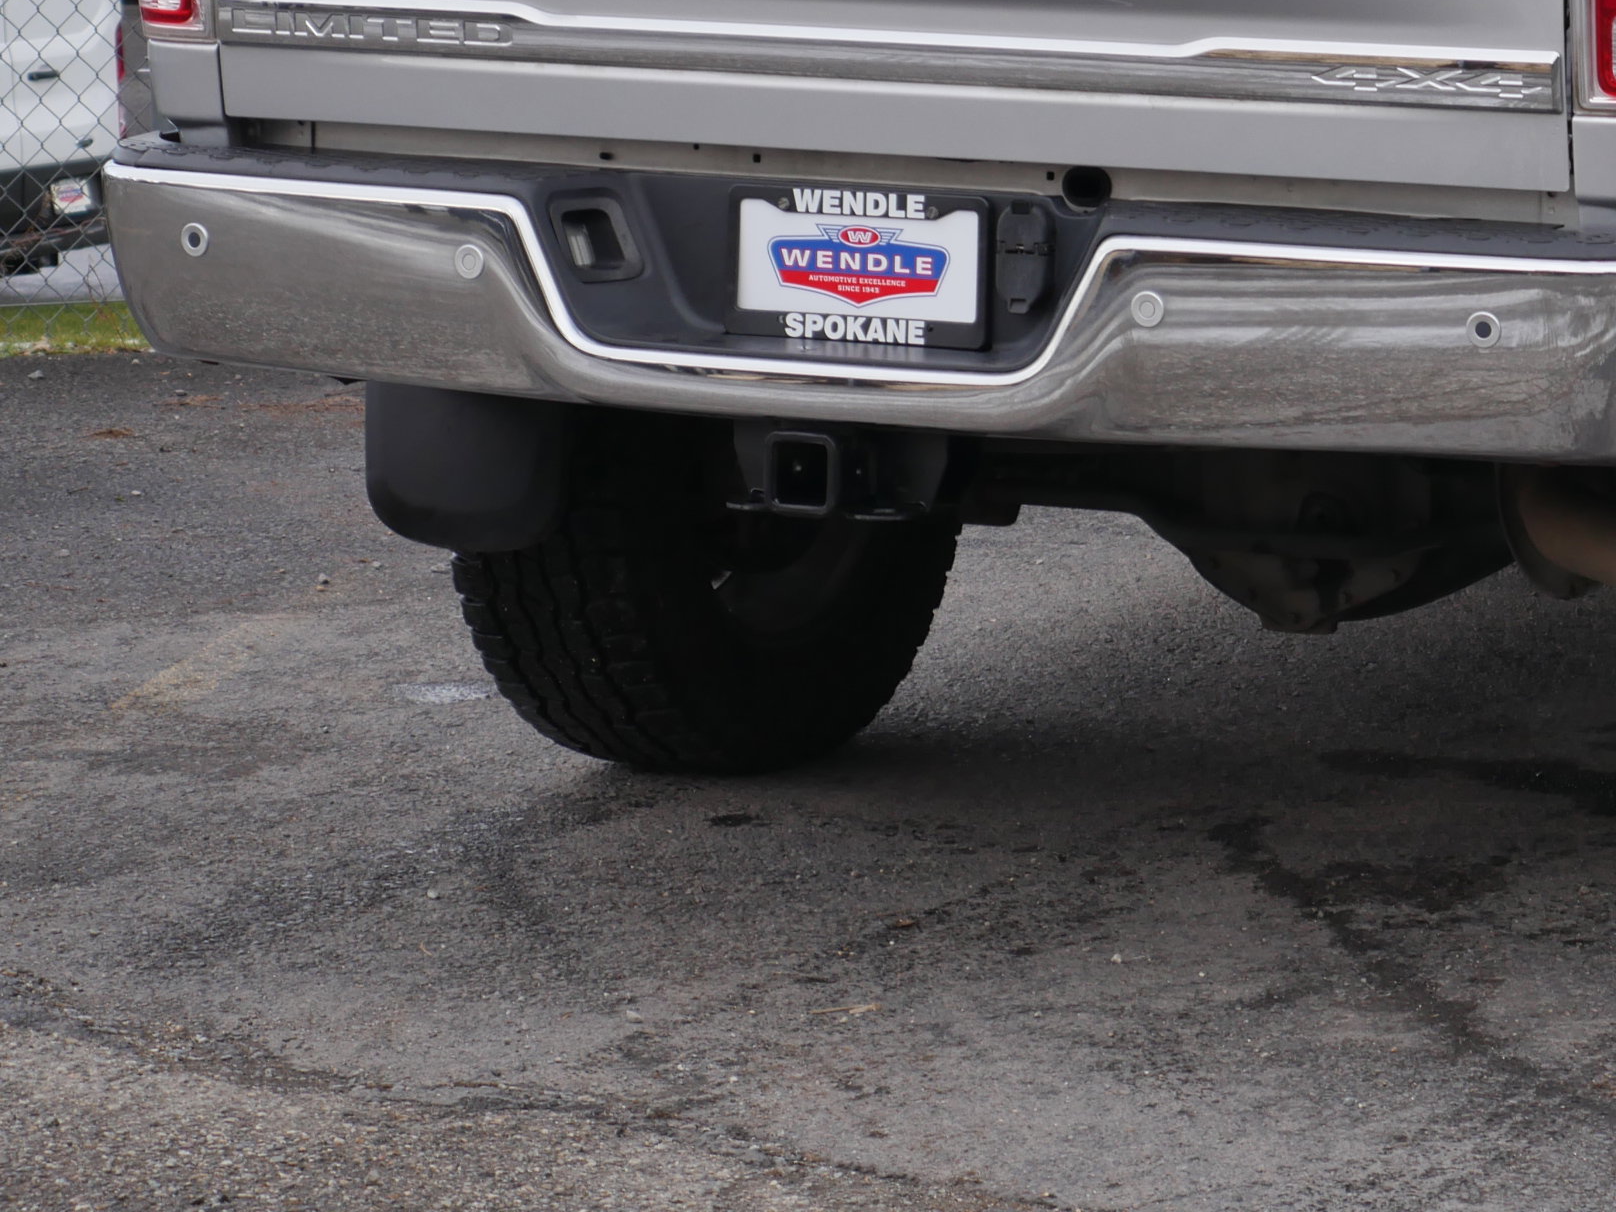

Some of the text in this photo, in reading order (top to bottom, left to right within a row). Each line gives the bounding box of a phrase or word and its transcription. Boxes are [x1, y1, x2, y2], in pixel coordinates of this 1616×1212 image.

[230, 7, 514, 47] LIMITED
[792, 187, 926, 220] WENDLE
[780, 247, 933, 276] WENDLE
[808, 274, 906, 287] AUTOMOTIVE EXCELLENCE
[837, 284, 860, 293] SINCE
[784, 312, 926, 345] SPOKANE
